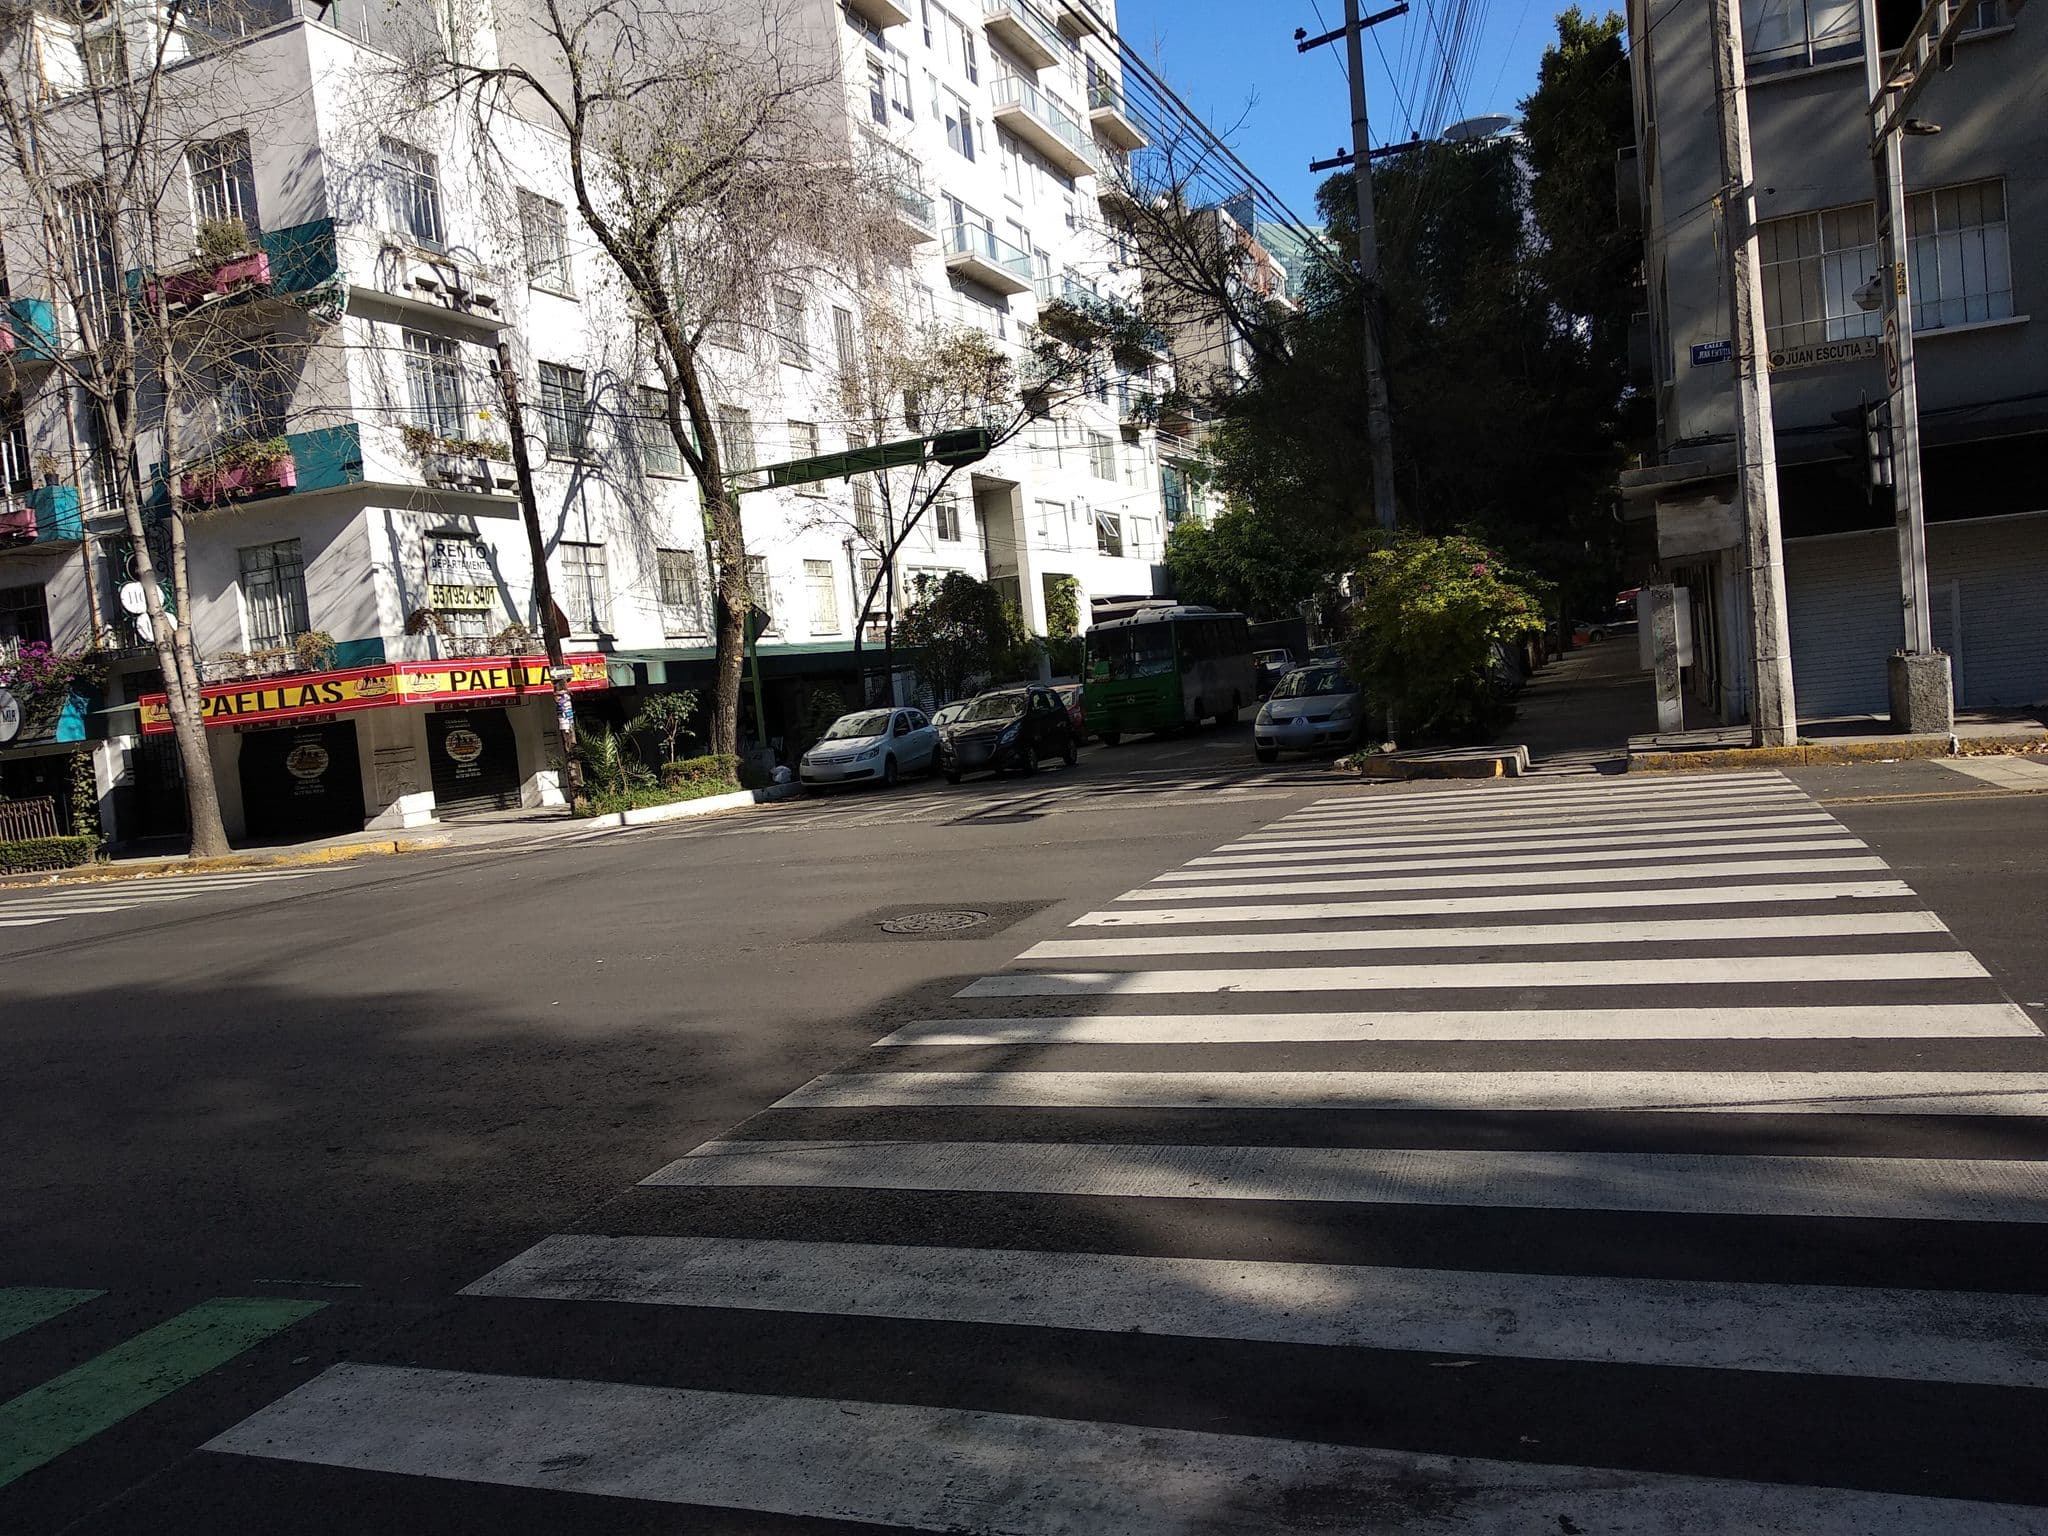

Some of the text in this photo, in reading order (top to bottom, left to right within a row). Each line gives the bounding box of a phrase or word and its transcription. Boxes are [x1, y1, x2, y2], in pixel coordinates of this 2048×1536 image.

[1786, 350, 1813, 365] JUAN
[1816, 343, 1861, 360] ESCUTIA
[436, 543, 486, 559] RENTO
[432, 558, 492, 571] DEPARTAMENTO
[450, 665, 571, 692] PAELLA
